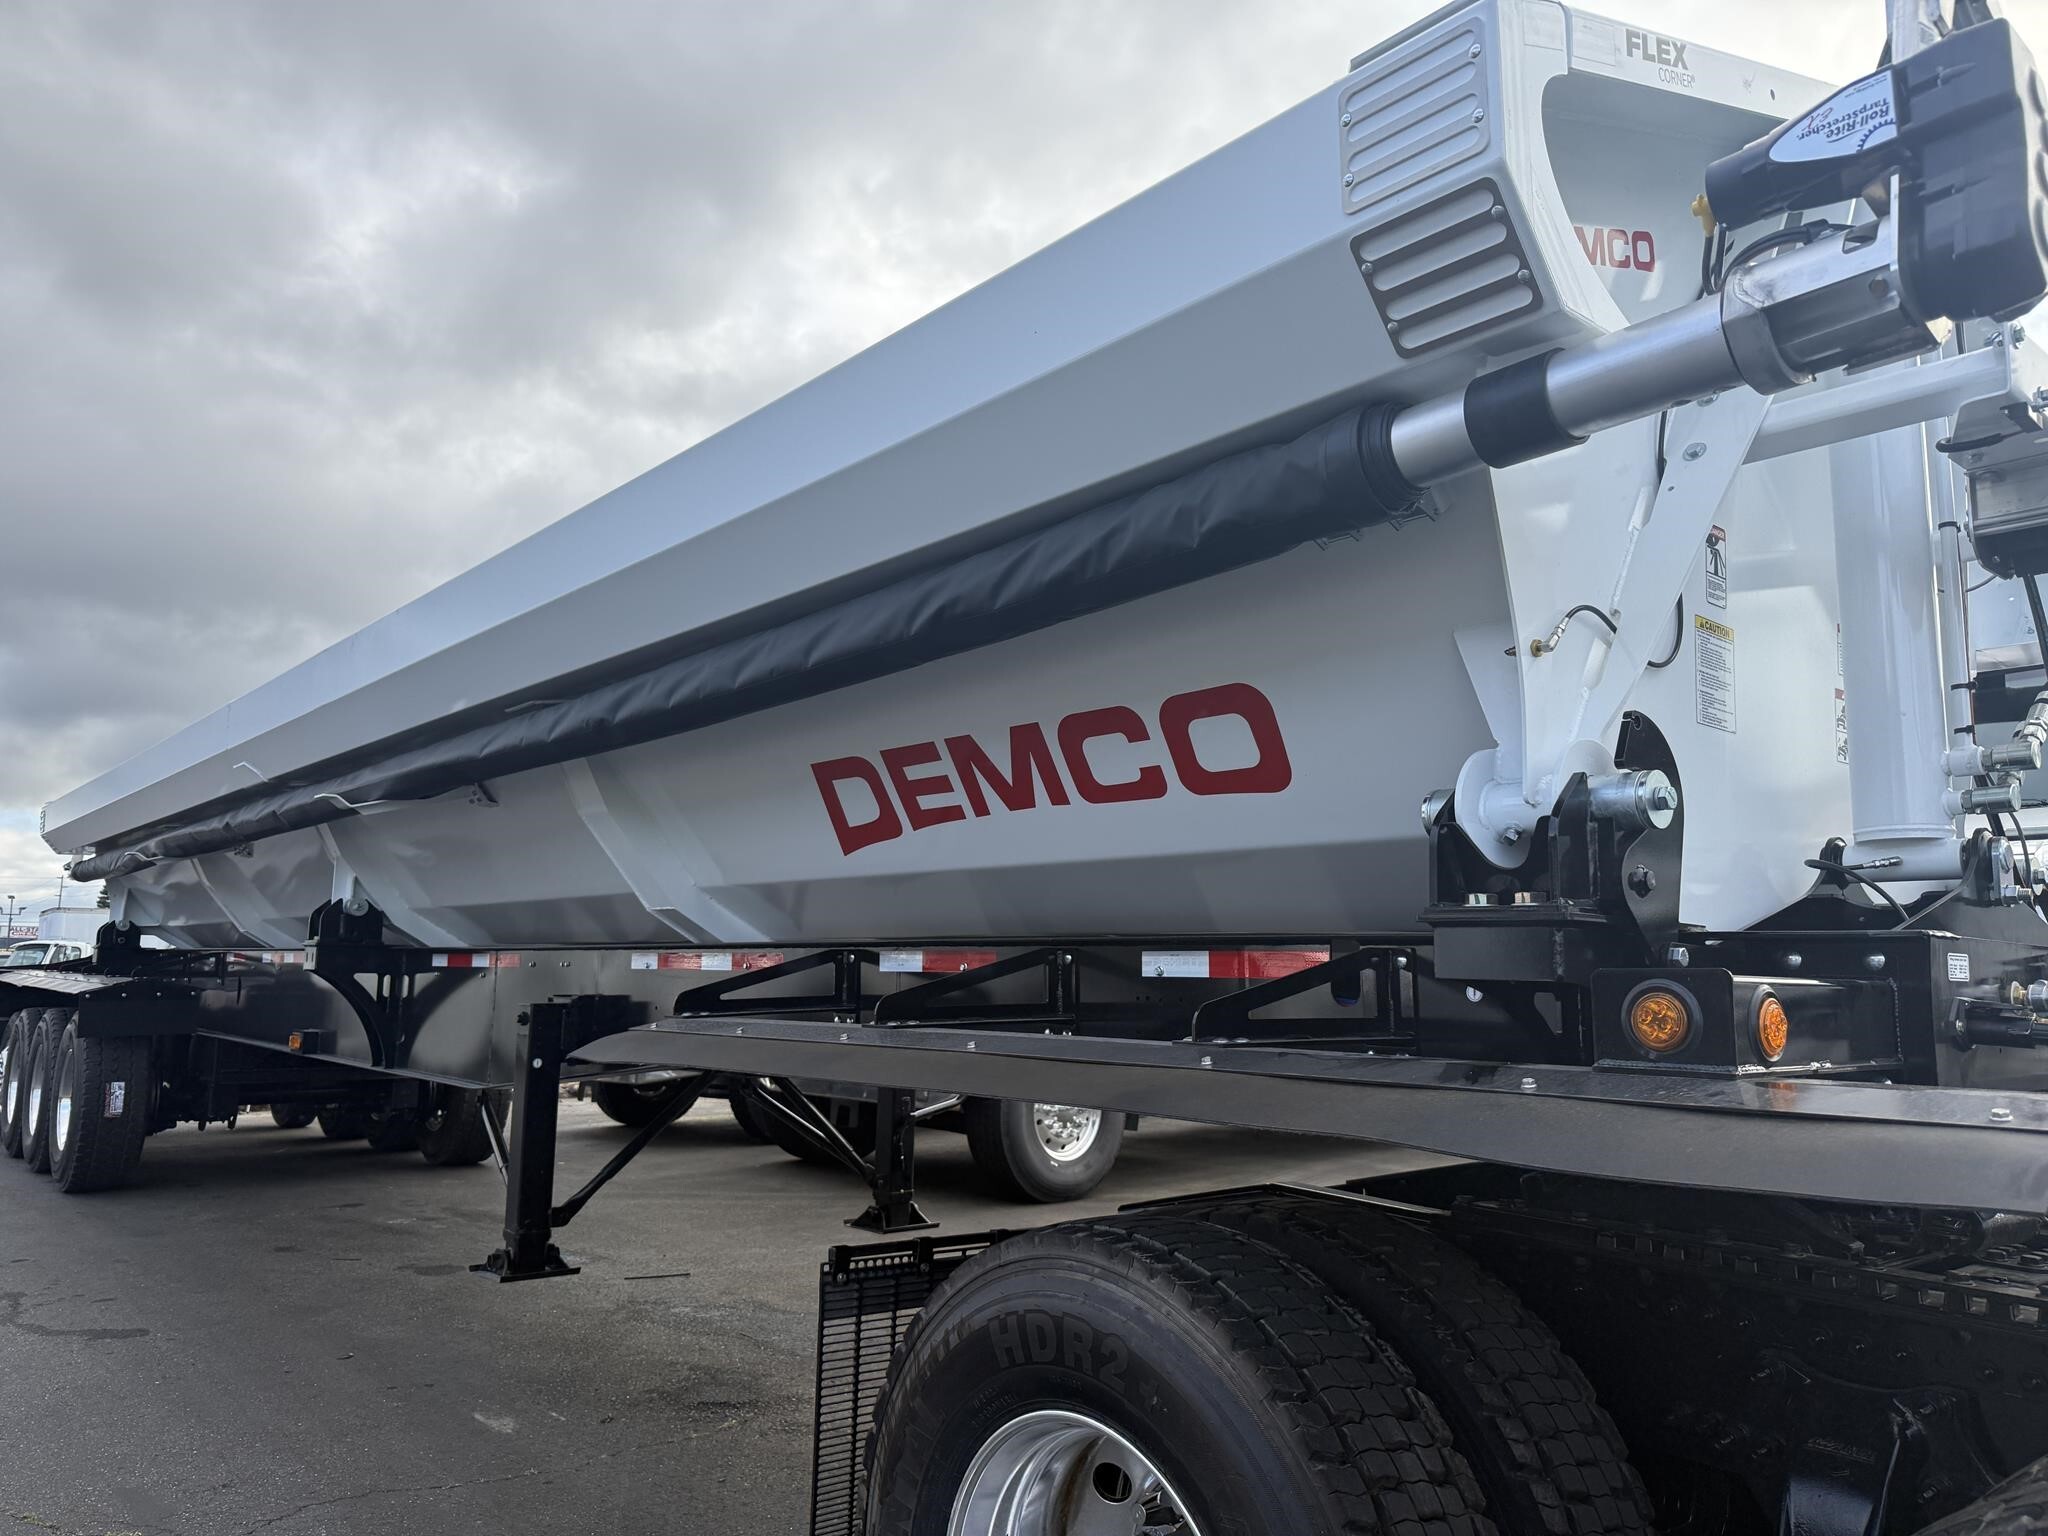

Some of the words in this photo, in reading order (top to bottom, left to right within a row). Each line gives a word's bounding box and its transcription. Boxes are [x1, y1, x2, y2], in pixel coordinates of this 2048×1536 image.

[1625, 28, 1689, 71] FLEX
[1704, 620, 1731, 638] CAUTION
[810, 682, 1293, 857] DEMCO
